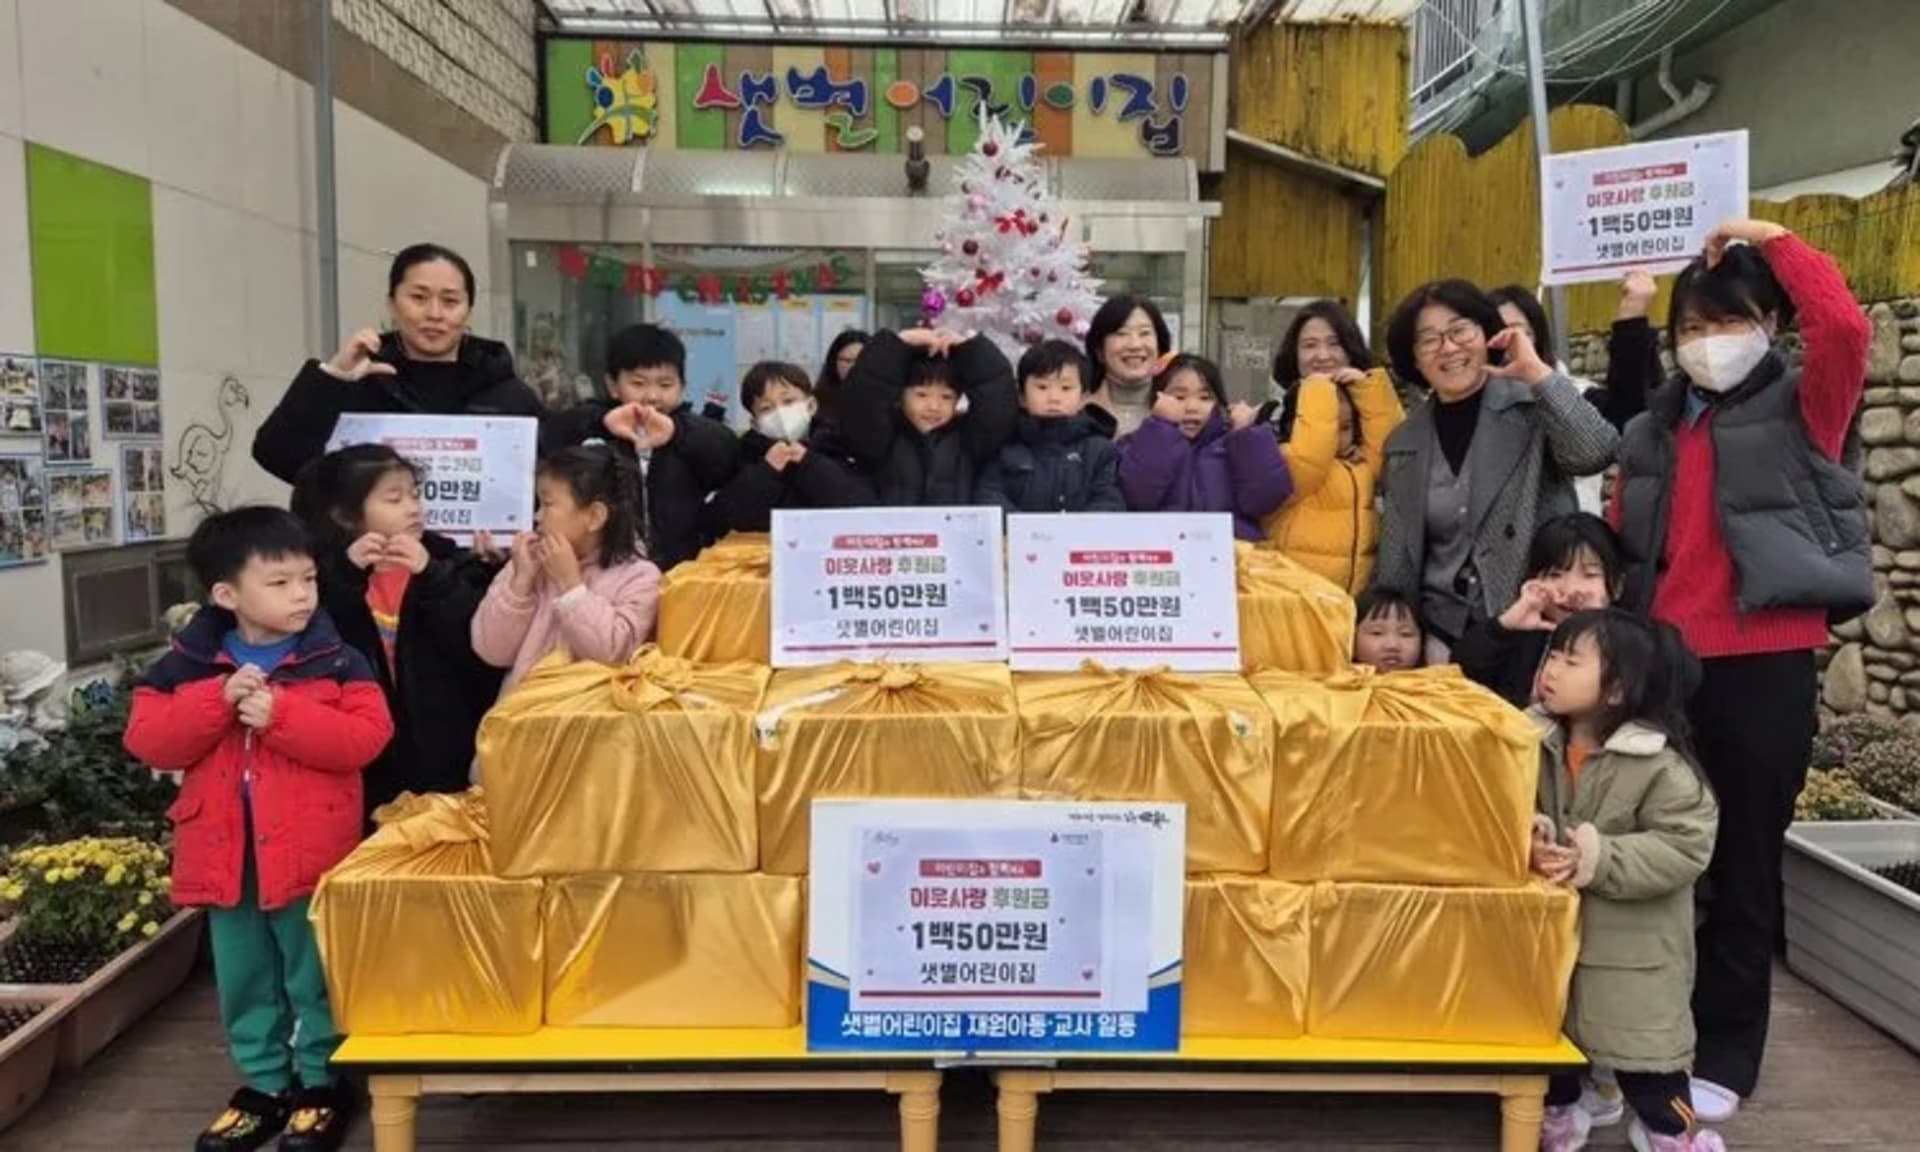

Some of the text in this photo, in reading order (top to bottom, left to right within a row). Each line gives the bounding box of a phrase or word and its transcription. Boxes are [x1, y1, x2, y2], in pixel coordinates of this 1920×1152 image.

[694, 64, 1191, 155] 샛별어린이집
[1588, 206, 1694, 236] 1백50만원
[425, 508, 473, 526] 린이집
[825, 555, 947, 575] 이웃사랑 후원금
[1063, 571, 1128, 588] 이웃사랑
[827, 583, 948, 610] 1백50만원
[1065, 596, 1181, 618] 1백50만원
[1075, 625, 1173, 643] 샛별어린이집
[910, 888, 1050, 910] 이웃사랑 후원금
[911, 921, 1049, 951] 1백50만원
[920, 962, 1036, 985] 샛별어린이집
[841, 1013, 961, 1037] 샛별어린이집
[1098, 1014, 1137, 1037] 일동
